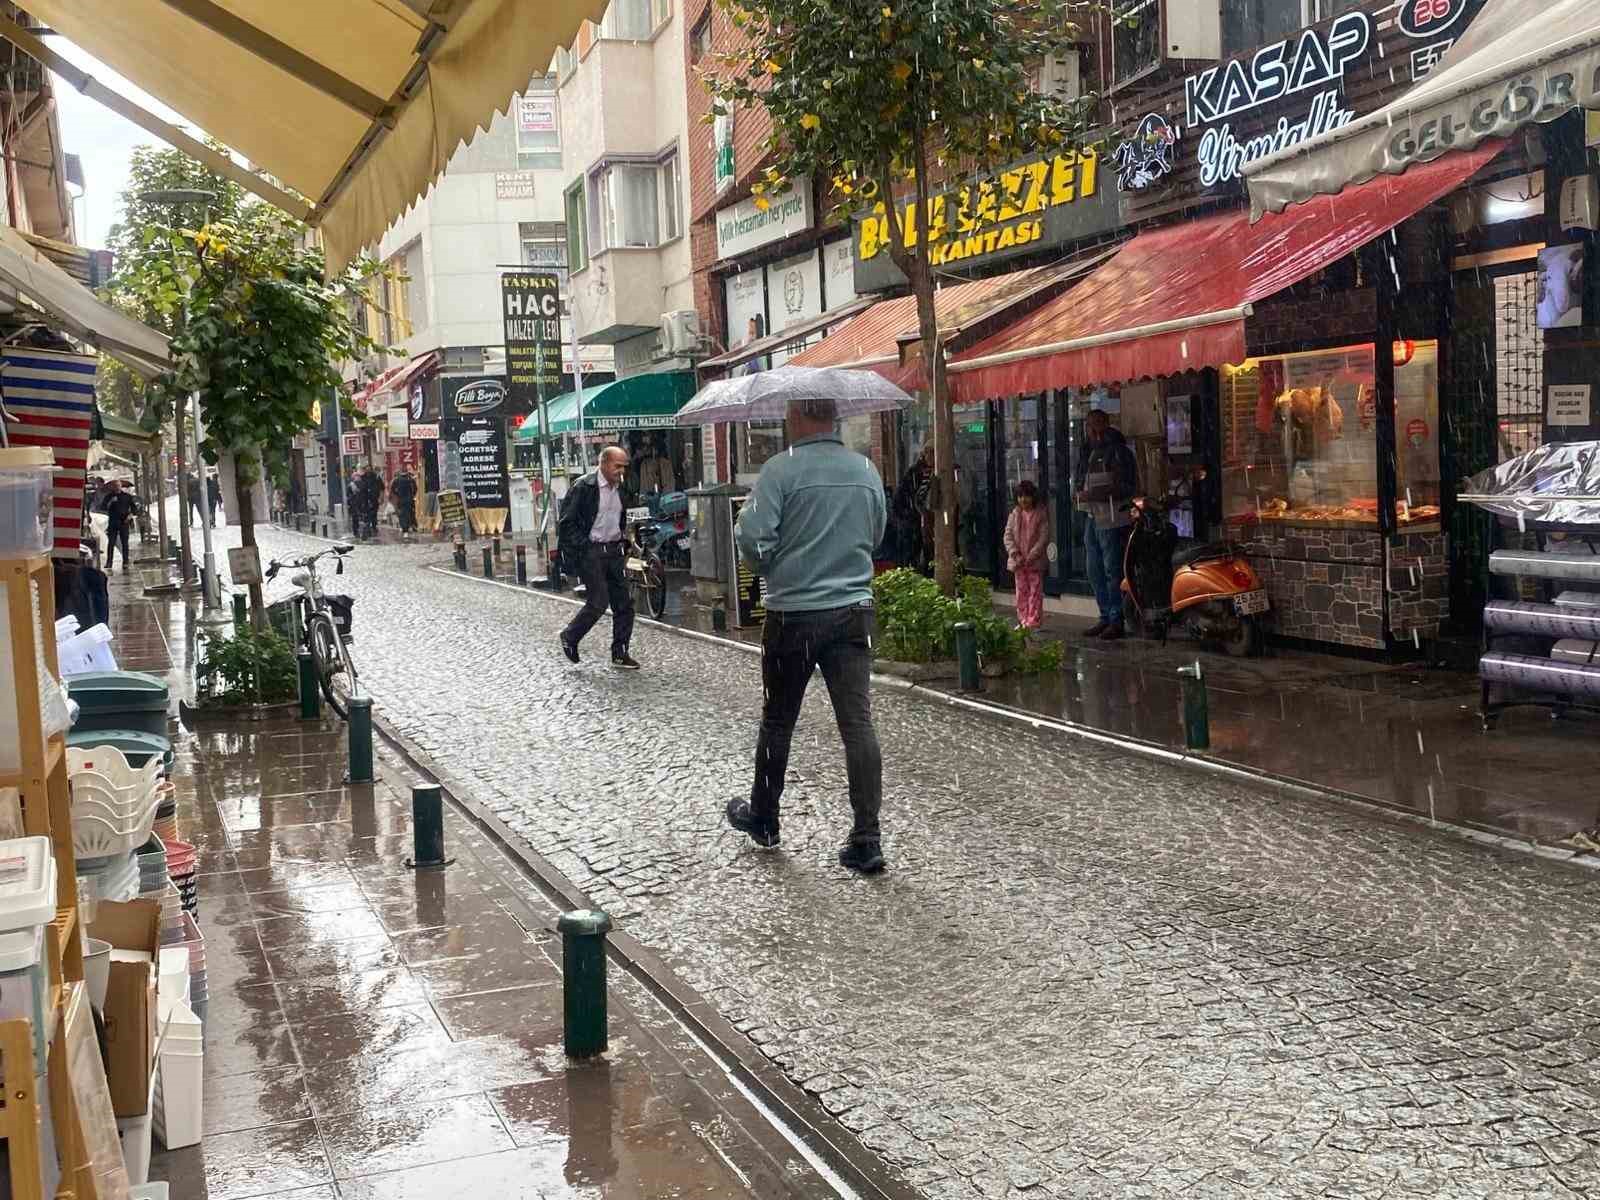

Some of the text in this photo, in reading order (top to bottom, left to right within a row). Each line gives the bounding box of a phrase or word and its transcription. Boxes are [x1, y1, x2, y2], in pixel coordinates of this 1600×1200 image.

[1414, 0, 1451, 27] 26
[1185, 11, 1370, 128] KASAP
[928, 218, 1043, 265] KANTASI
[507, 294, 556, 316] HAC
[477, 389, 501, 403] Boya
